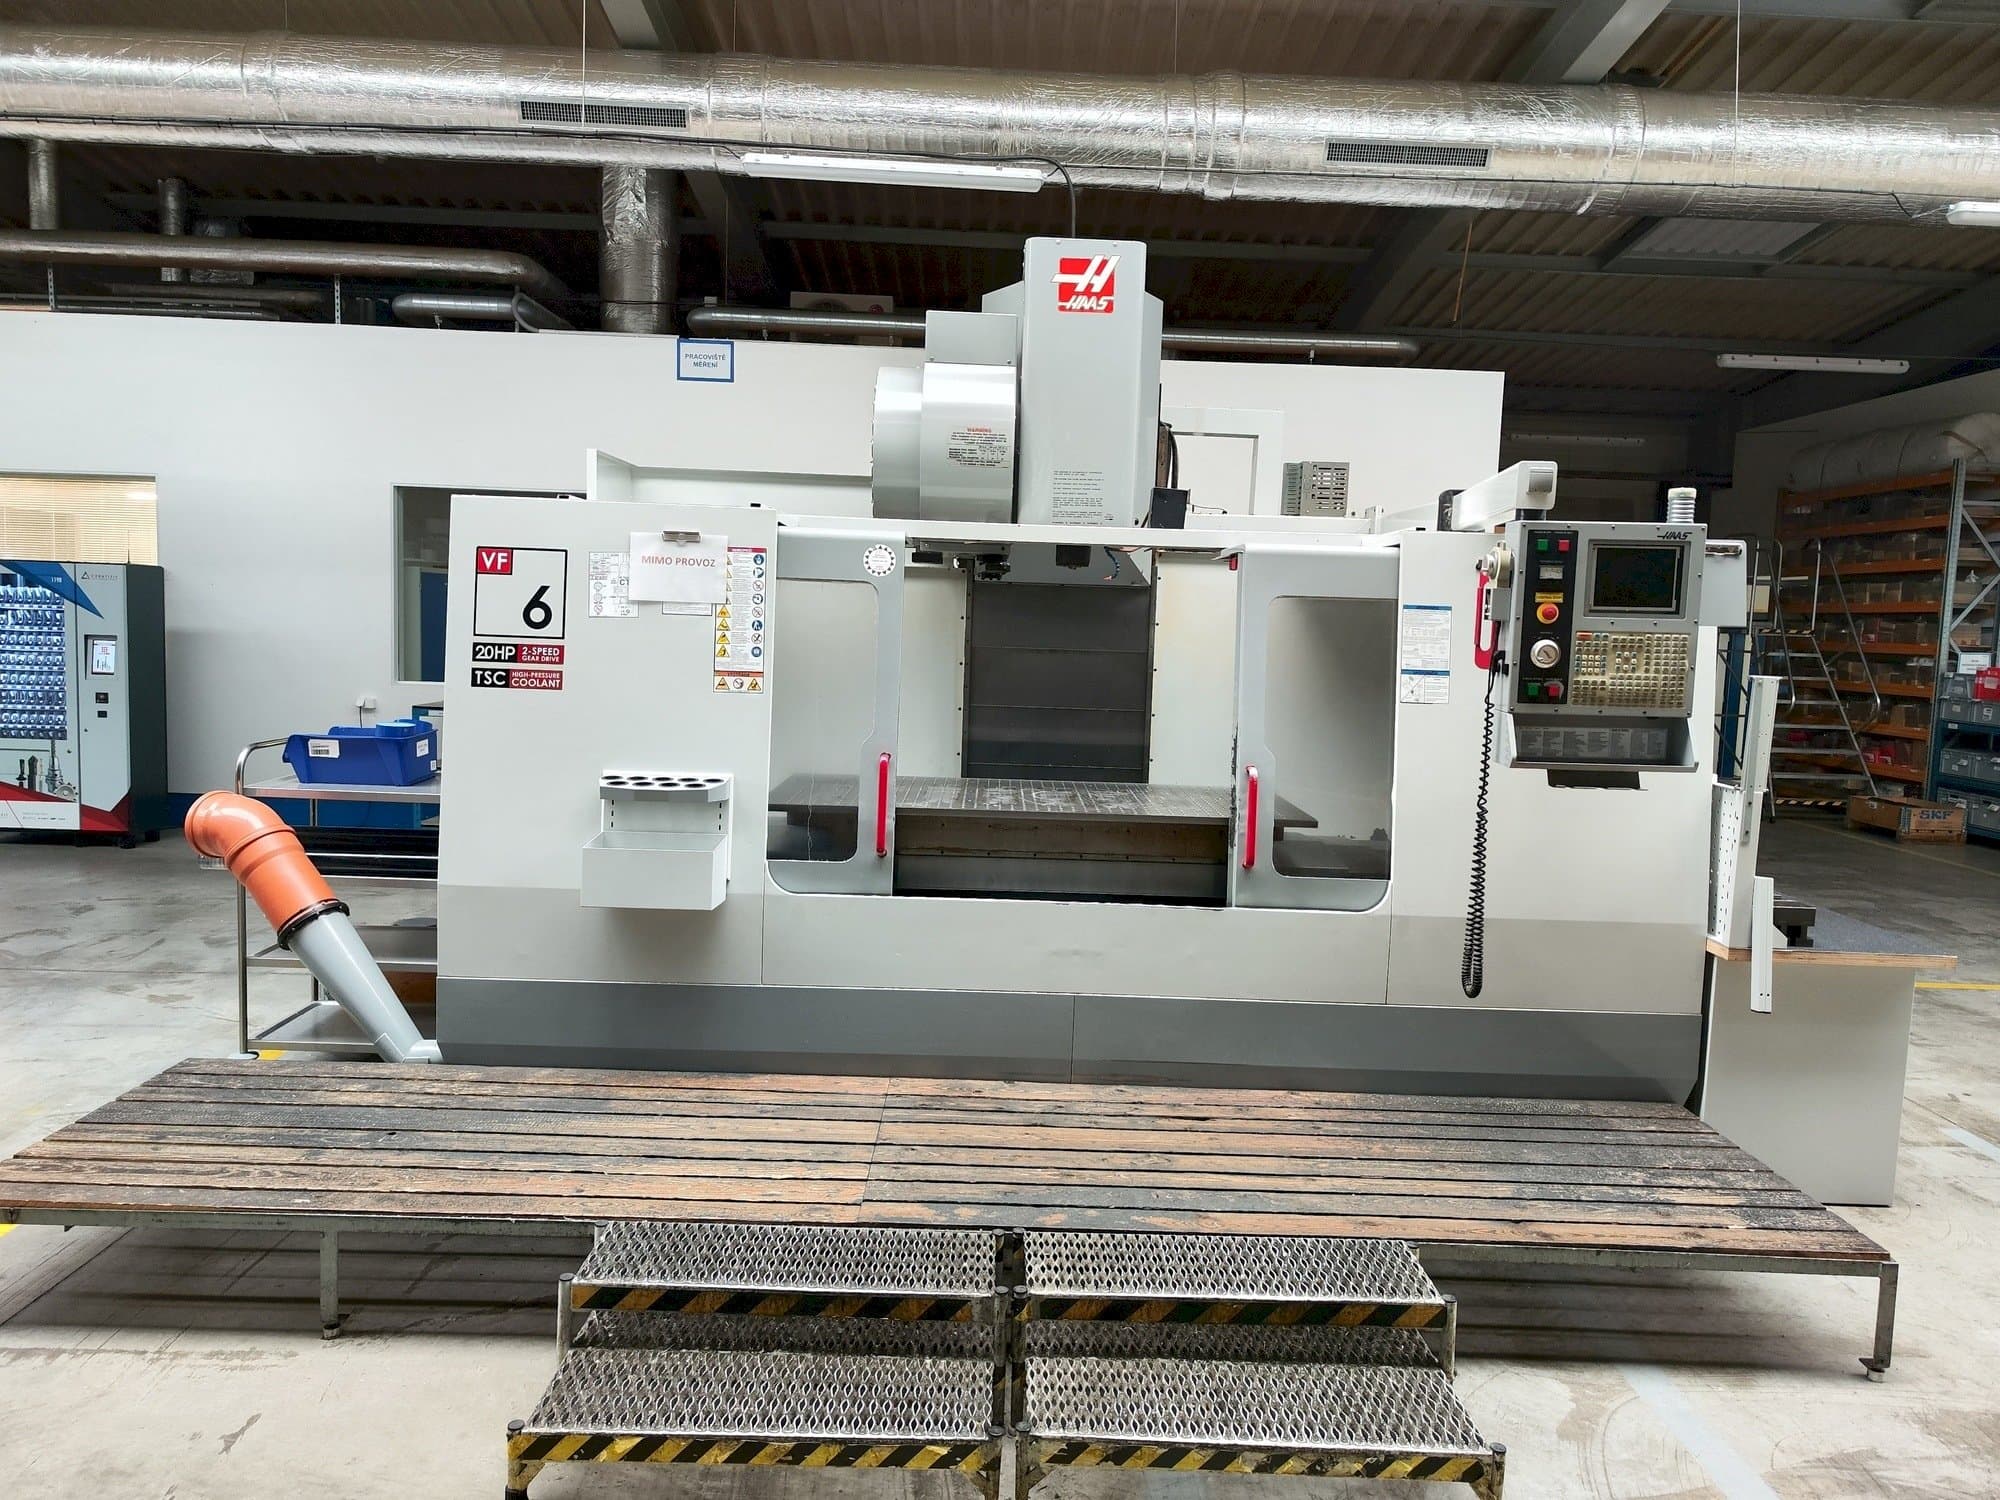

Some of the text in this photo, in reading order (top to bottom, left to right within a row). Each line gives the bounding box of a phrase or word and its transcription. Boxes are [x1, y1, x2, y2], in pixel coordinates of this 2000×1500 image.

[1058, 295, 1114, 310] HAAS
[1657, 531, 1692, 540] HAAS
[481, 552, 508, 570] VF
[641, 555, 715, 568] MIMO PROVOZ
[523, 585, 552, 630] 6
[475, 645, 516, 660] 20HP
[522, 647, 560, 656] 2-SPEED
[475, 670, 506, 685] TSC
[511, 678, 560, 688] COOLANT
[1920, 810, 1953, 820] SKF
